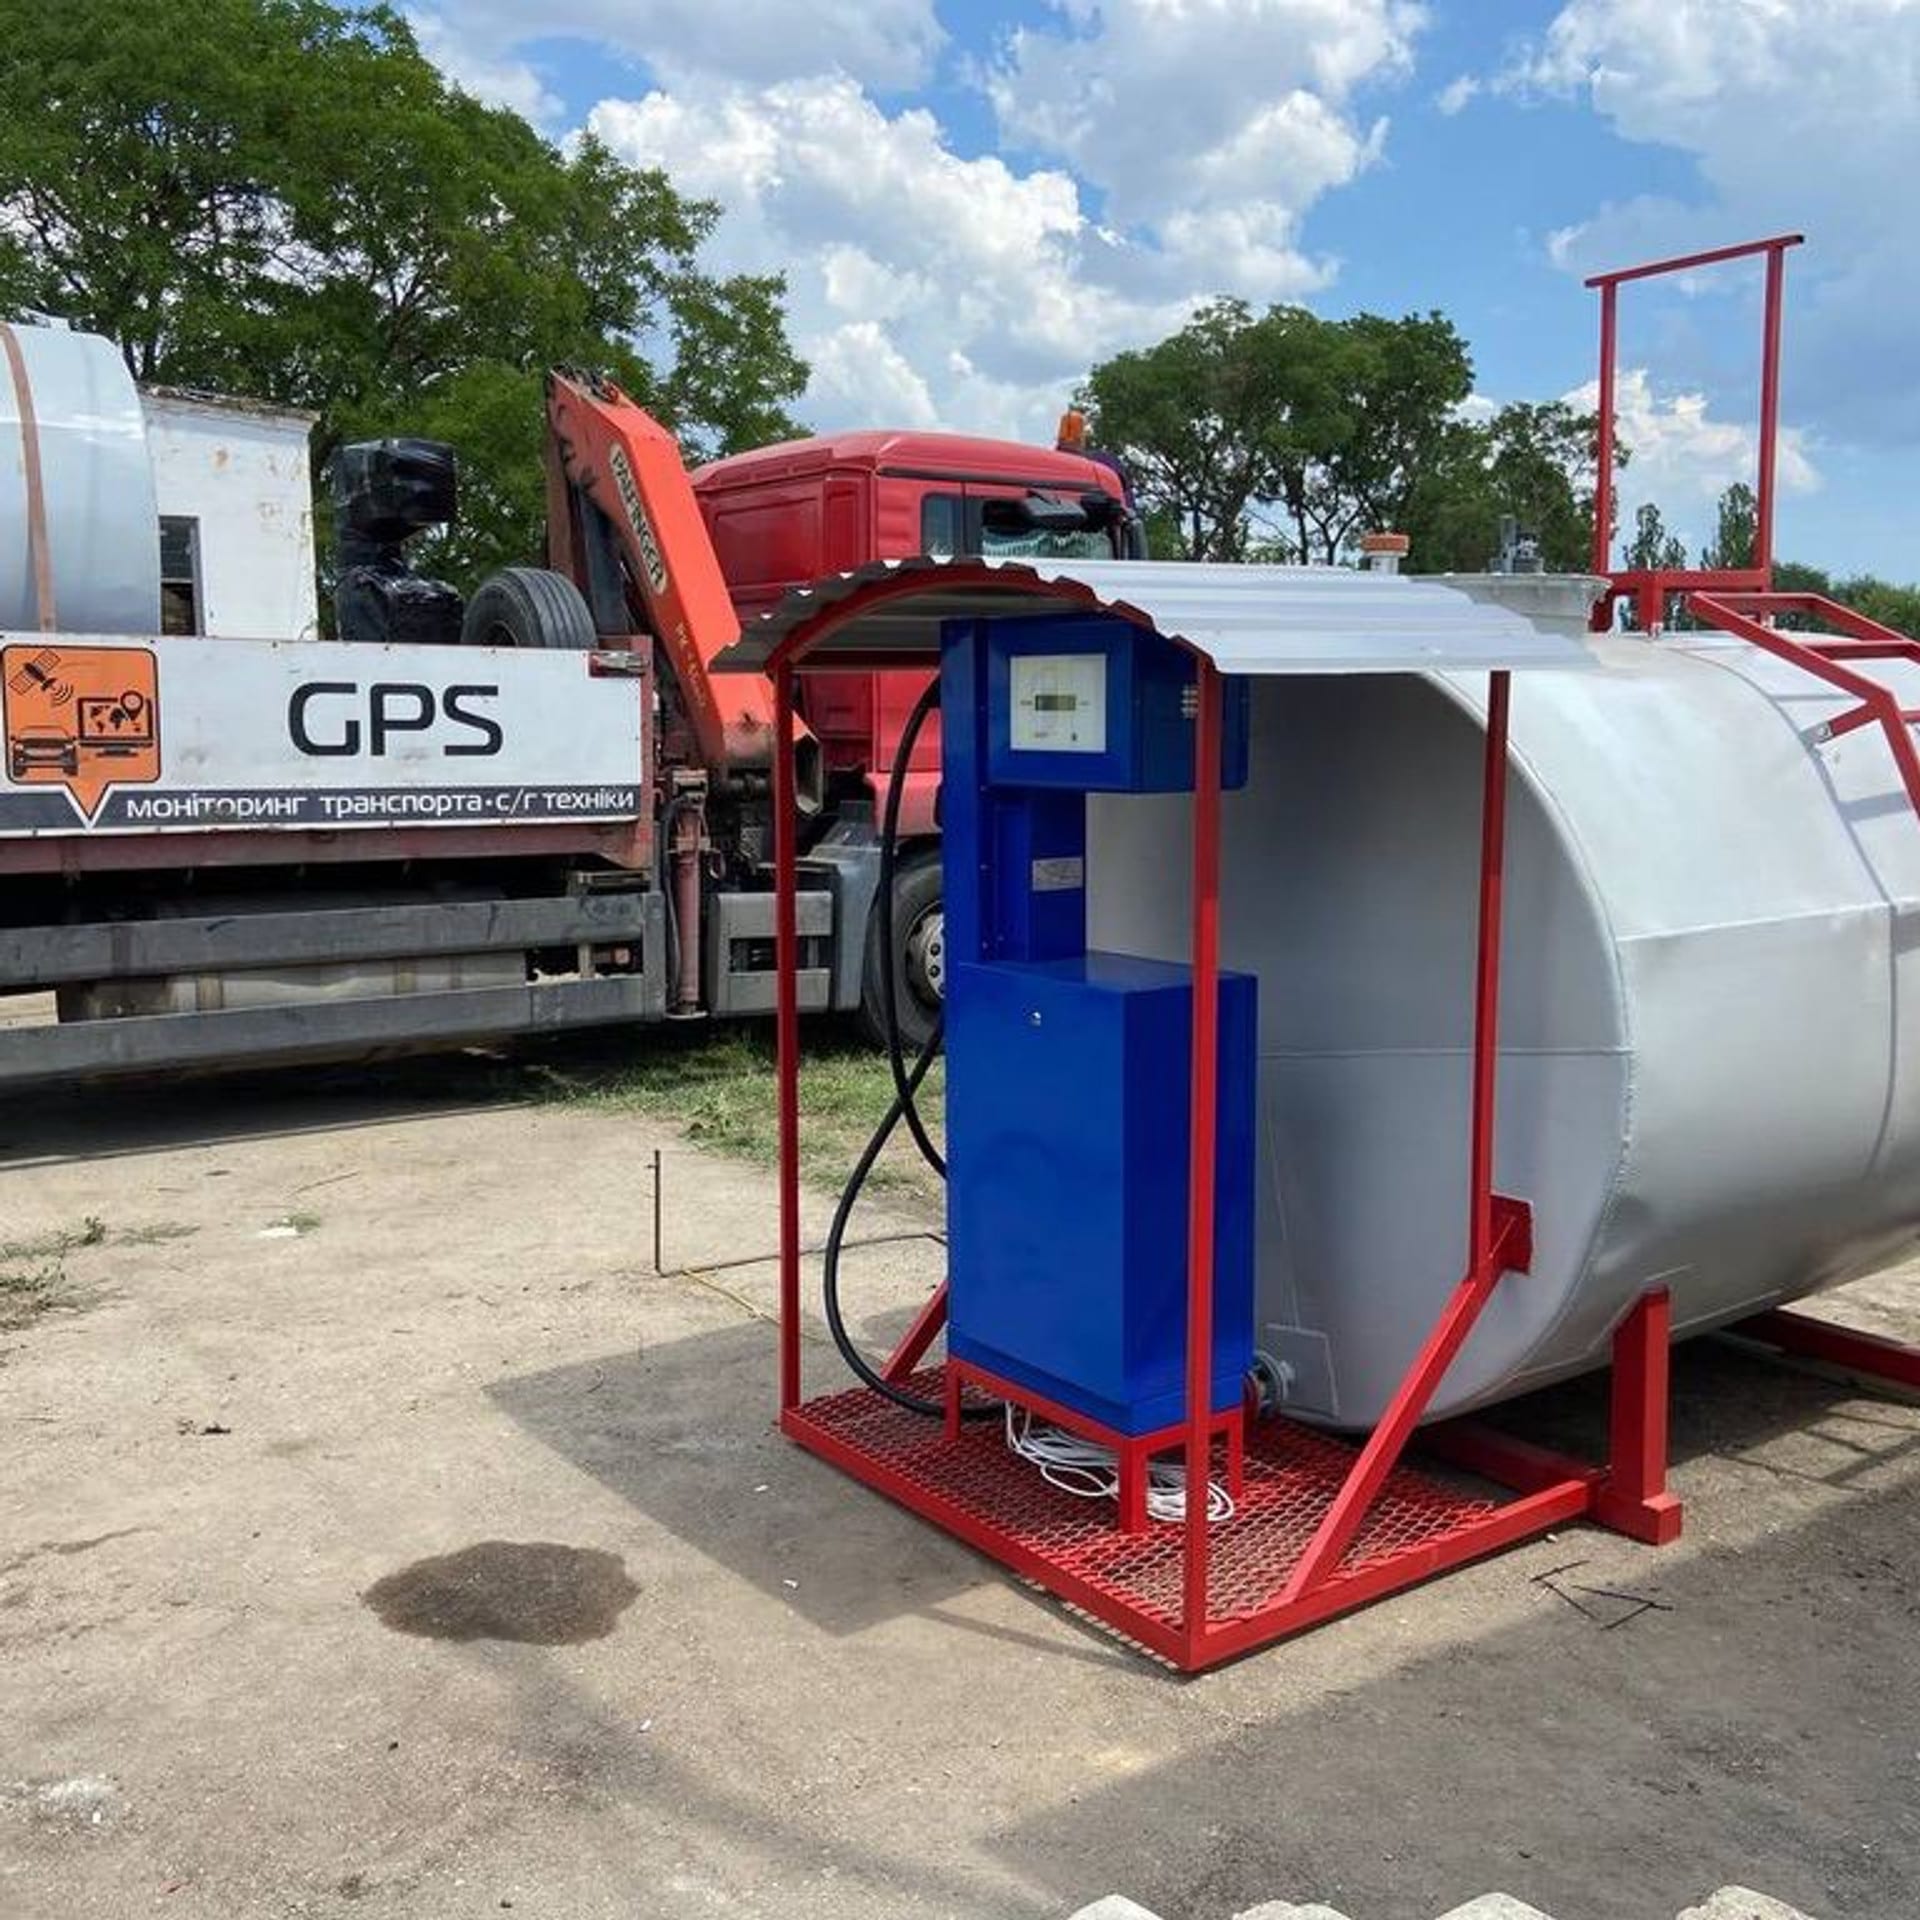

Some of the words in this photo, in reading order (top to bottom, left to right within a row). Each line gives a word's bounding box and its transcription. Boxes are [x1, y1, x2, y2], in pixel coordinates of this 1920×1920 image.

[288, 682, 503, 756] GPS
[127, 793, 307, 818] моніторинг
[542, 788, 634, 810] техніки
